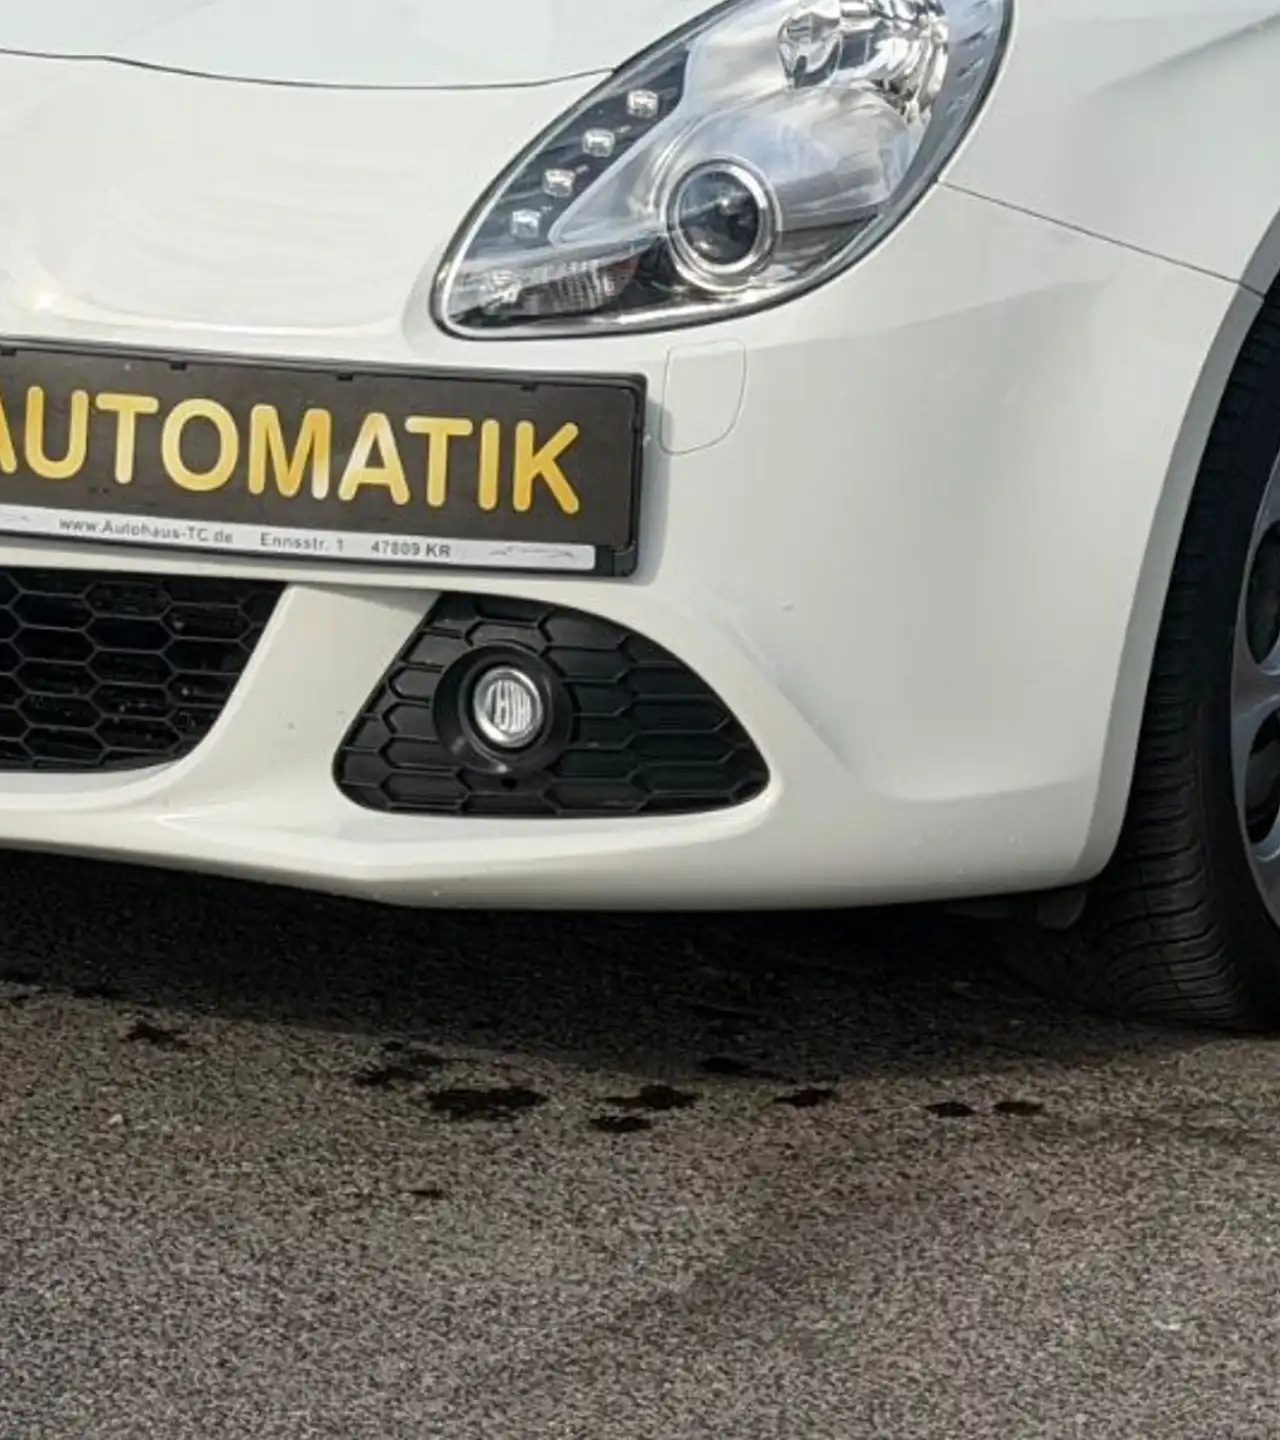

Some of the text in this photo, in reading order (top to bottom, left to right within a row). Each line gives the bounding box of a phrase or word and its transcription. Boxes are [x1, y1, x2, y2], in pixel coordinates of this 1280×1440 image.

[58, 517, 234, 545] www.Autohaus-TC.de
[260, 531, 330, 552] Ennsstr.
[371, 539, 421, 557] 47809
[426, 543, 451, 558] KR
